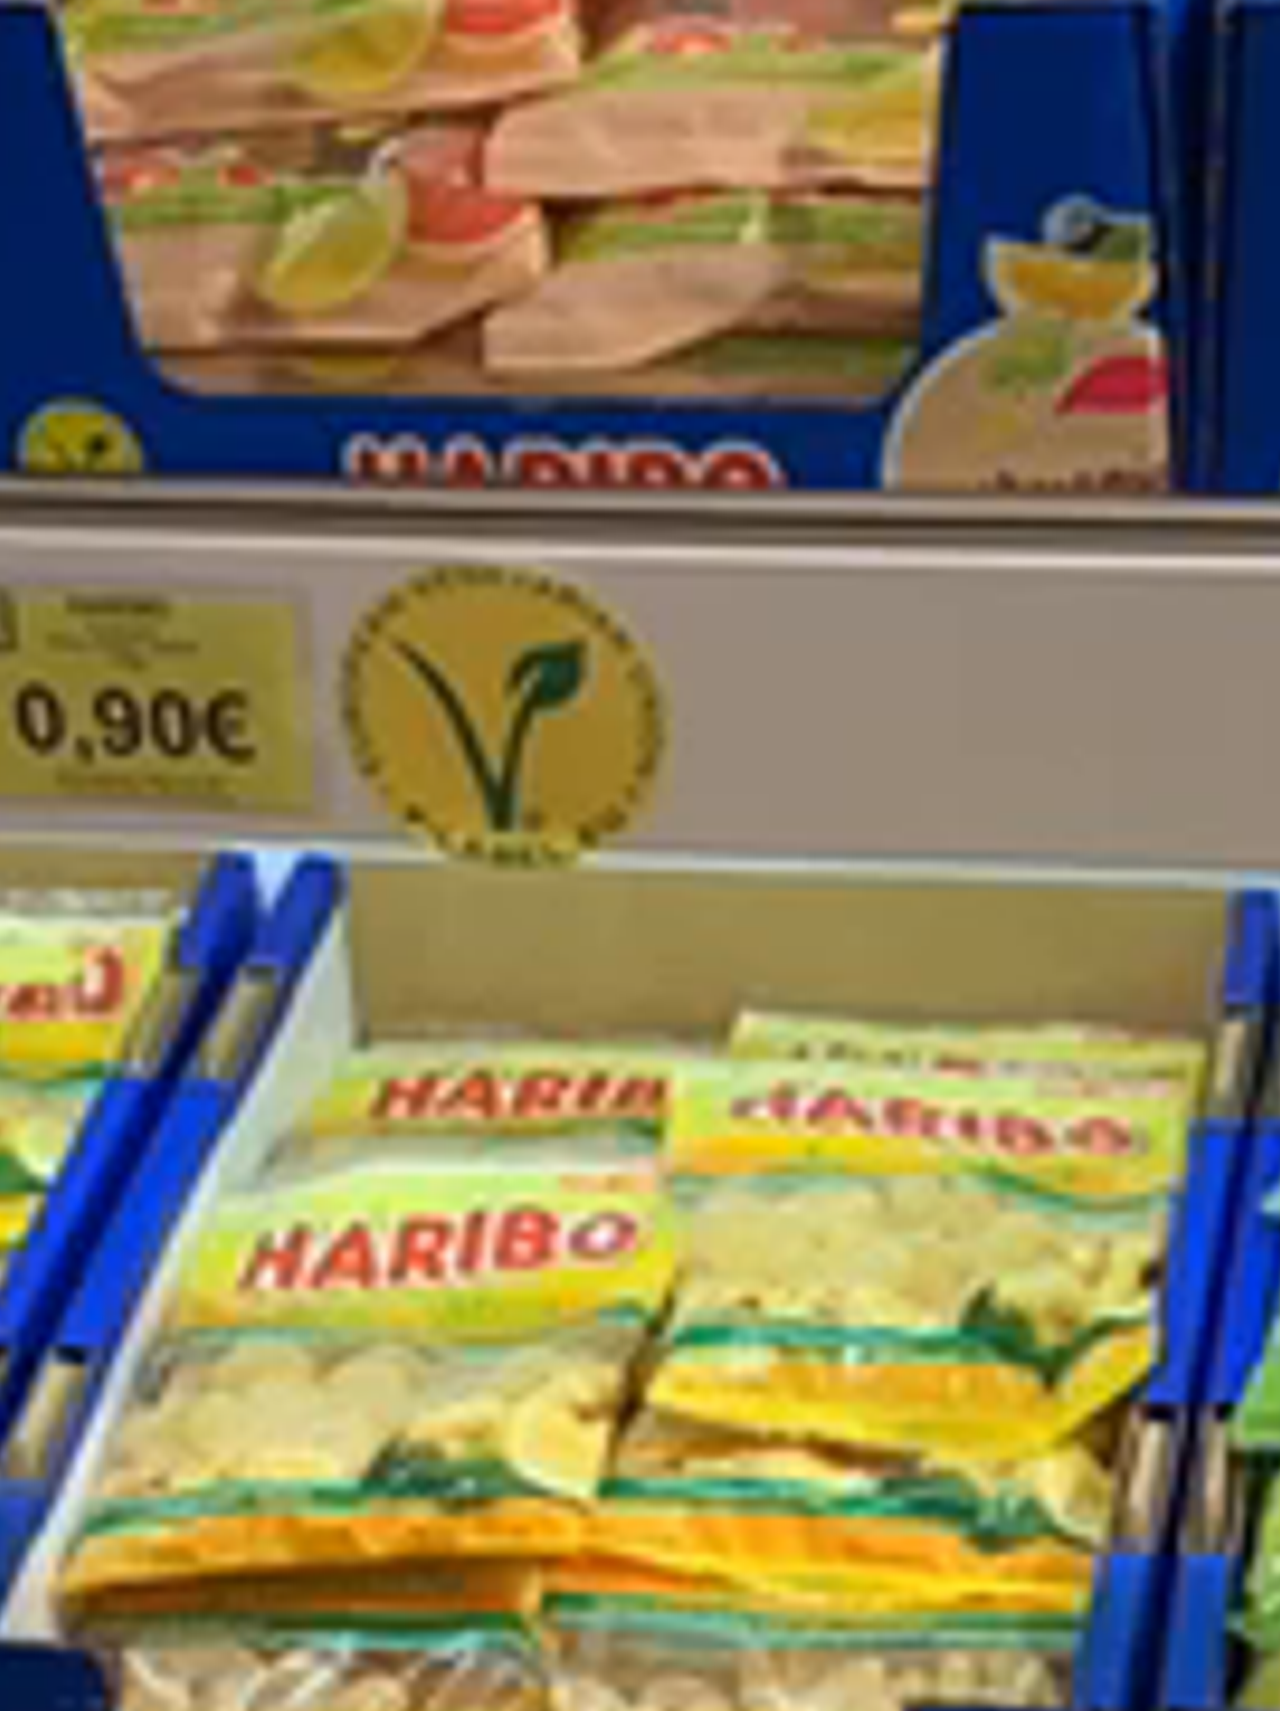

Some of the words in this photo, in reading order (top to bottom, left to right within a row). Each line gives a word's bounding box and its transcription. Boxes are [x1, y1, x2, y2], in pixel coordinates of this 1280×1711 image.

[15, 682, 256, 764] 0,90€
[368, 1067, 670, 1123] HARIB
[238, 1203, 638, 1291] HARIBO
